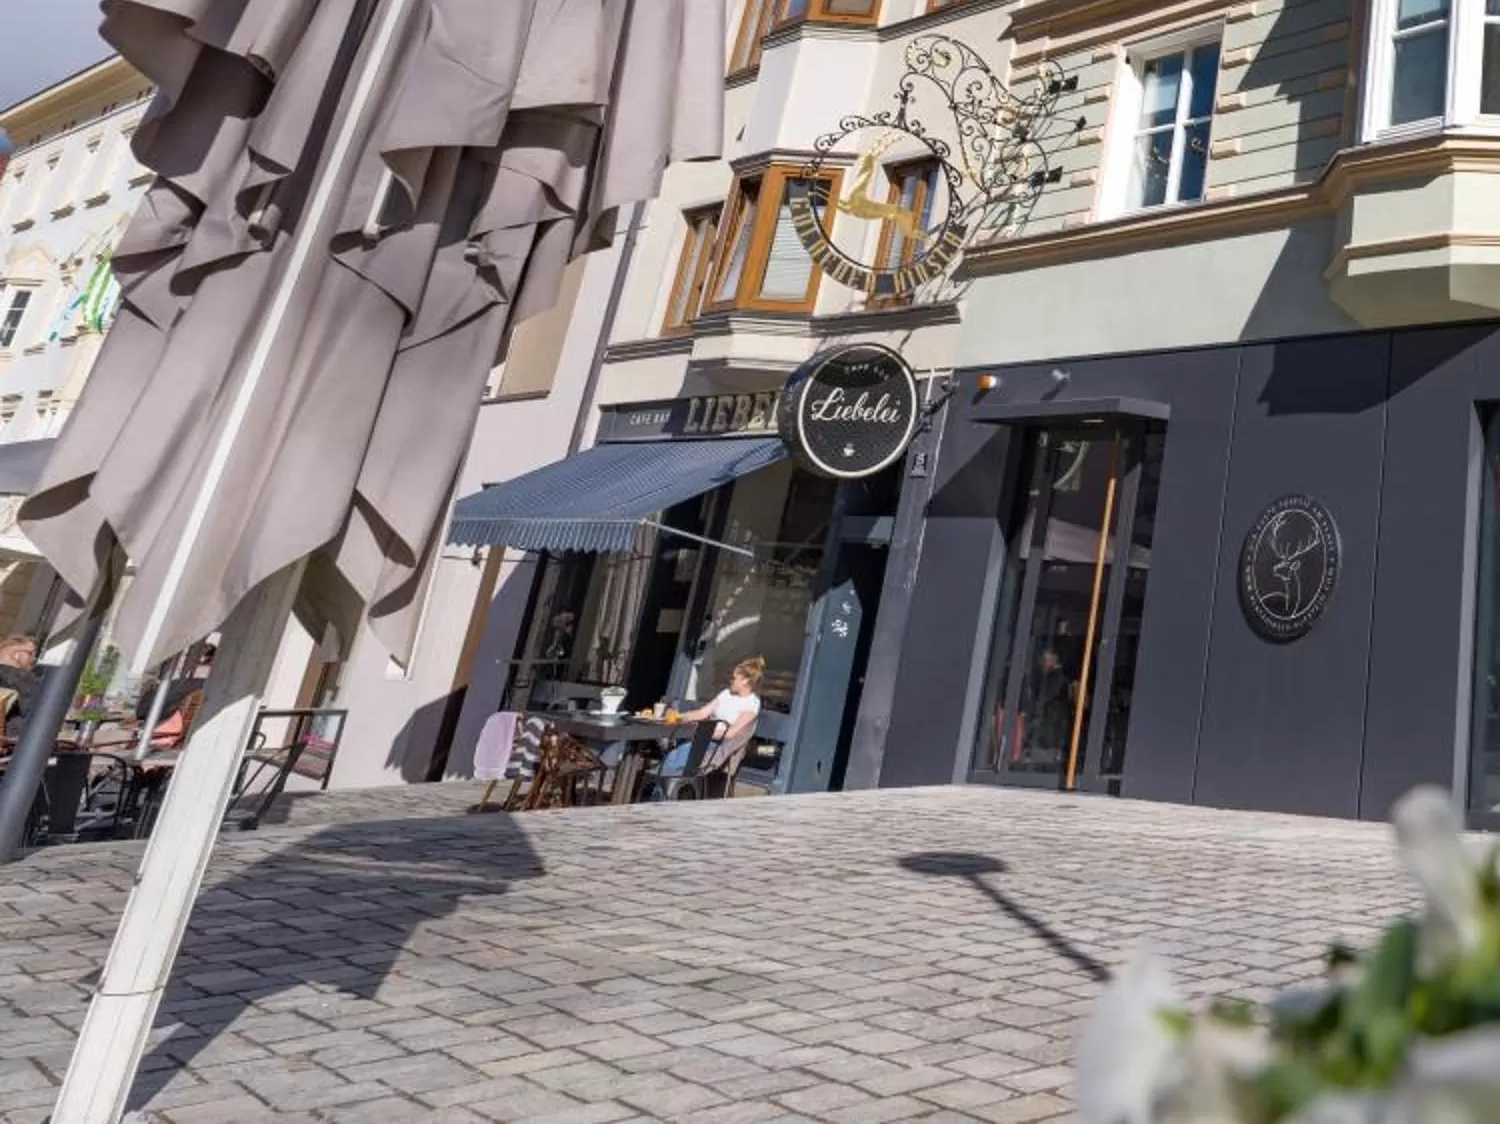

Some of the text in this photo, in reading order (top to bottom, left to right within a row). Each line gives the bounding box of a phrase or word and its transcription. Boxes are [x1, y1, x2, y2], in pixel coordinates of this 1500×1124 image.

[893, 230, 963, 295] HIRSCH
[683, 394, 780, 433] LIEBEL
[811, 387, 900, 423] Liebelei
